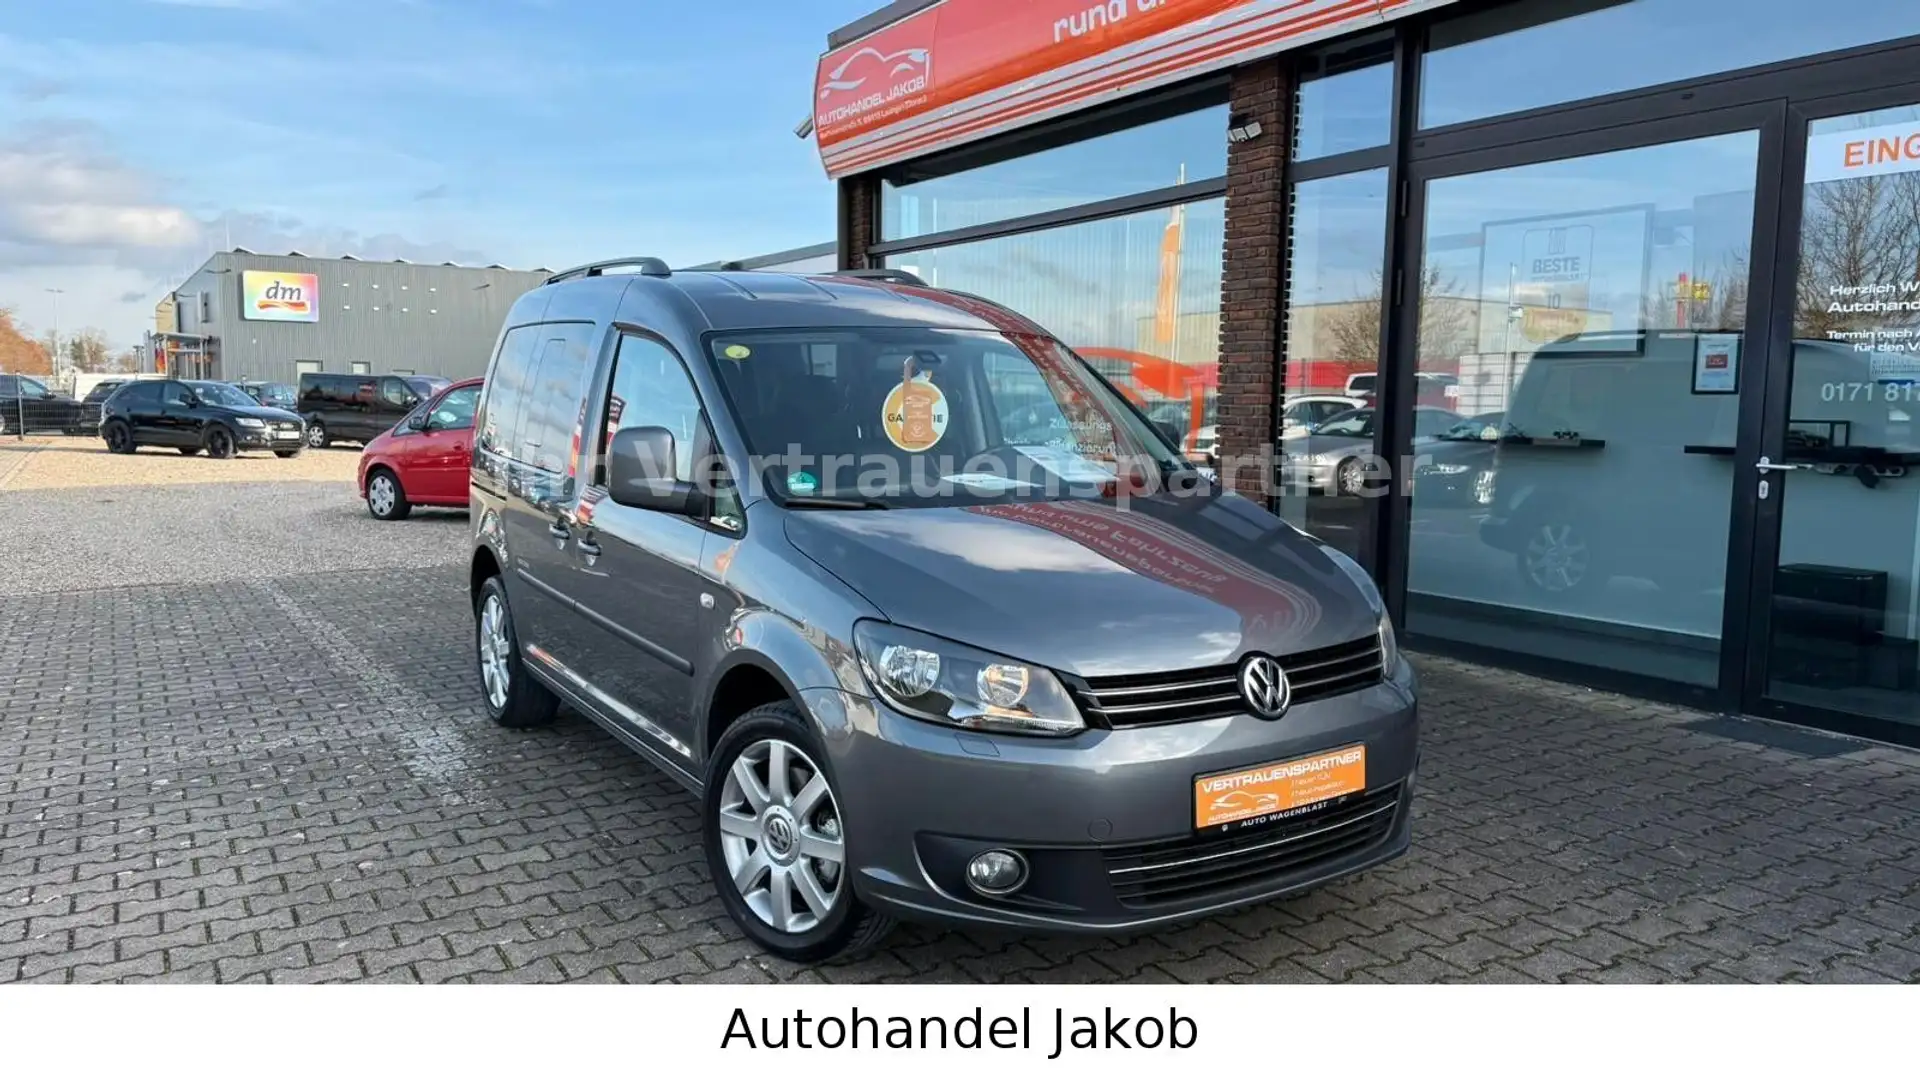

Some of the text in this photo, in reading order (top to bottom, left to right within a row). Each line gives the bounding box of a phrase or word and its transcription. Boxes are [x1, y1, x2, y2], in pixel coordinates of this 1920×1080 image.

[1053, 0, 1127, 43] rund
[818, 75, 925, 126] AUTOHANDEL JAKOB
[1532, 256, 1580, 273] BESTE
[266, 280, 301, 300] dm
[1829, 283, 1896, 295] Herzlich
[1826, 329, 1875, 340] Termin
[1877, 328, 1913, 338] nach
[1853, 341, 1876, 352] für
[1878, 341, 1905, 352] den
[1821, 382, 1874, 401] 0171
[887, 413, 945, 423] GAIE
[1201, 750, 1362, 793] VERTRAUENSPARTNER
[1241, 816, 1267, 828] AUTO
[1269, 801, 1329, 822] WAGENBLAST
